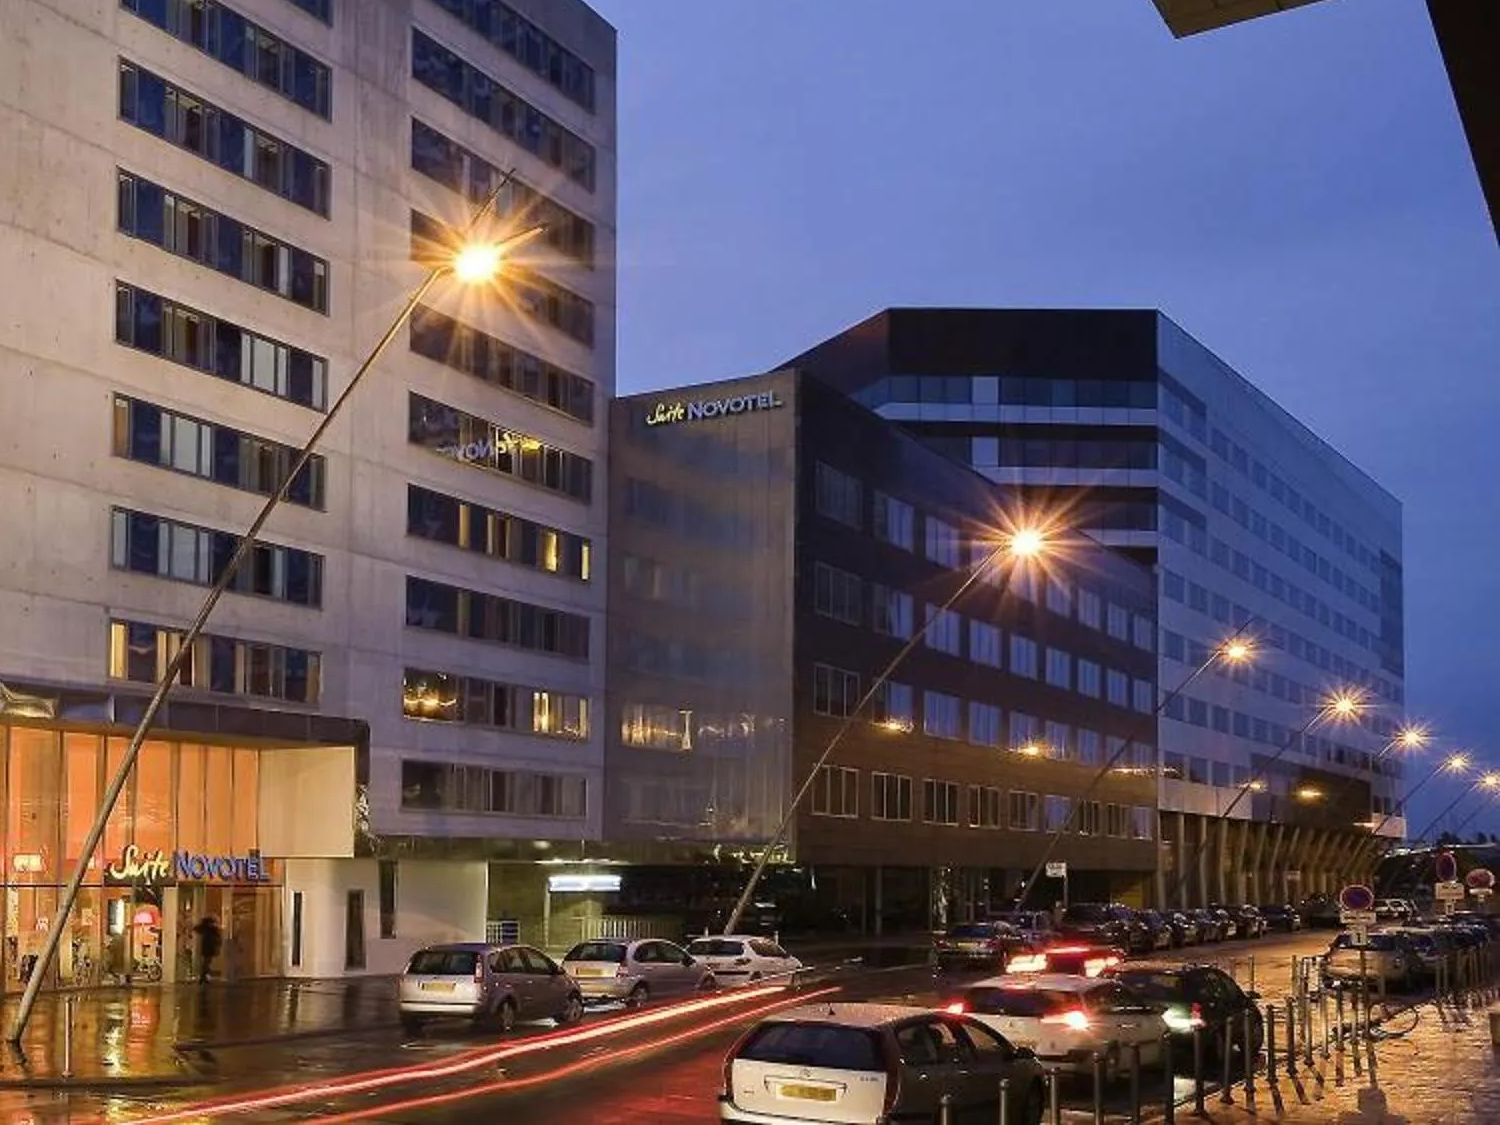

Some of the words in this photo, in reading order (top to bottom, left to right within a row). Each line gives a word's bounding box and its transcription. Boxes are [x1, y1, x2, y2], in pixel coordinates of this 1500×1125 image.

[687, 391, 783, 420] NOVOTEL
[110, 844, 169, 885] Suite
[174, 849, 269, 881] NOVOTEL
